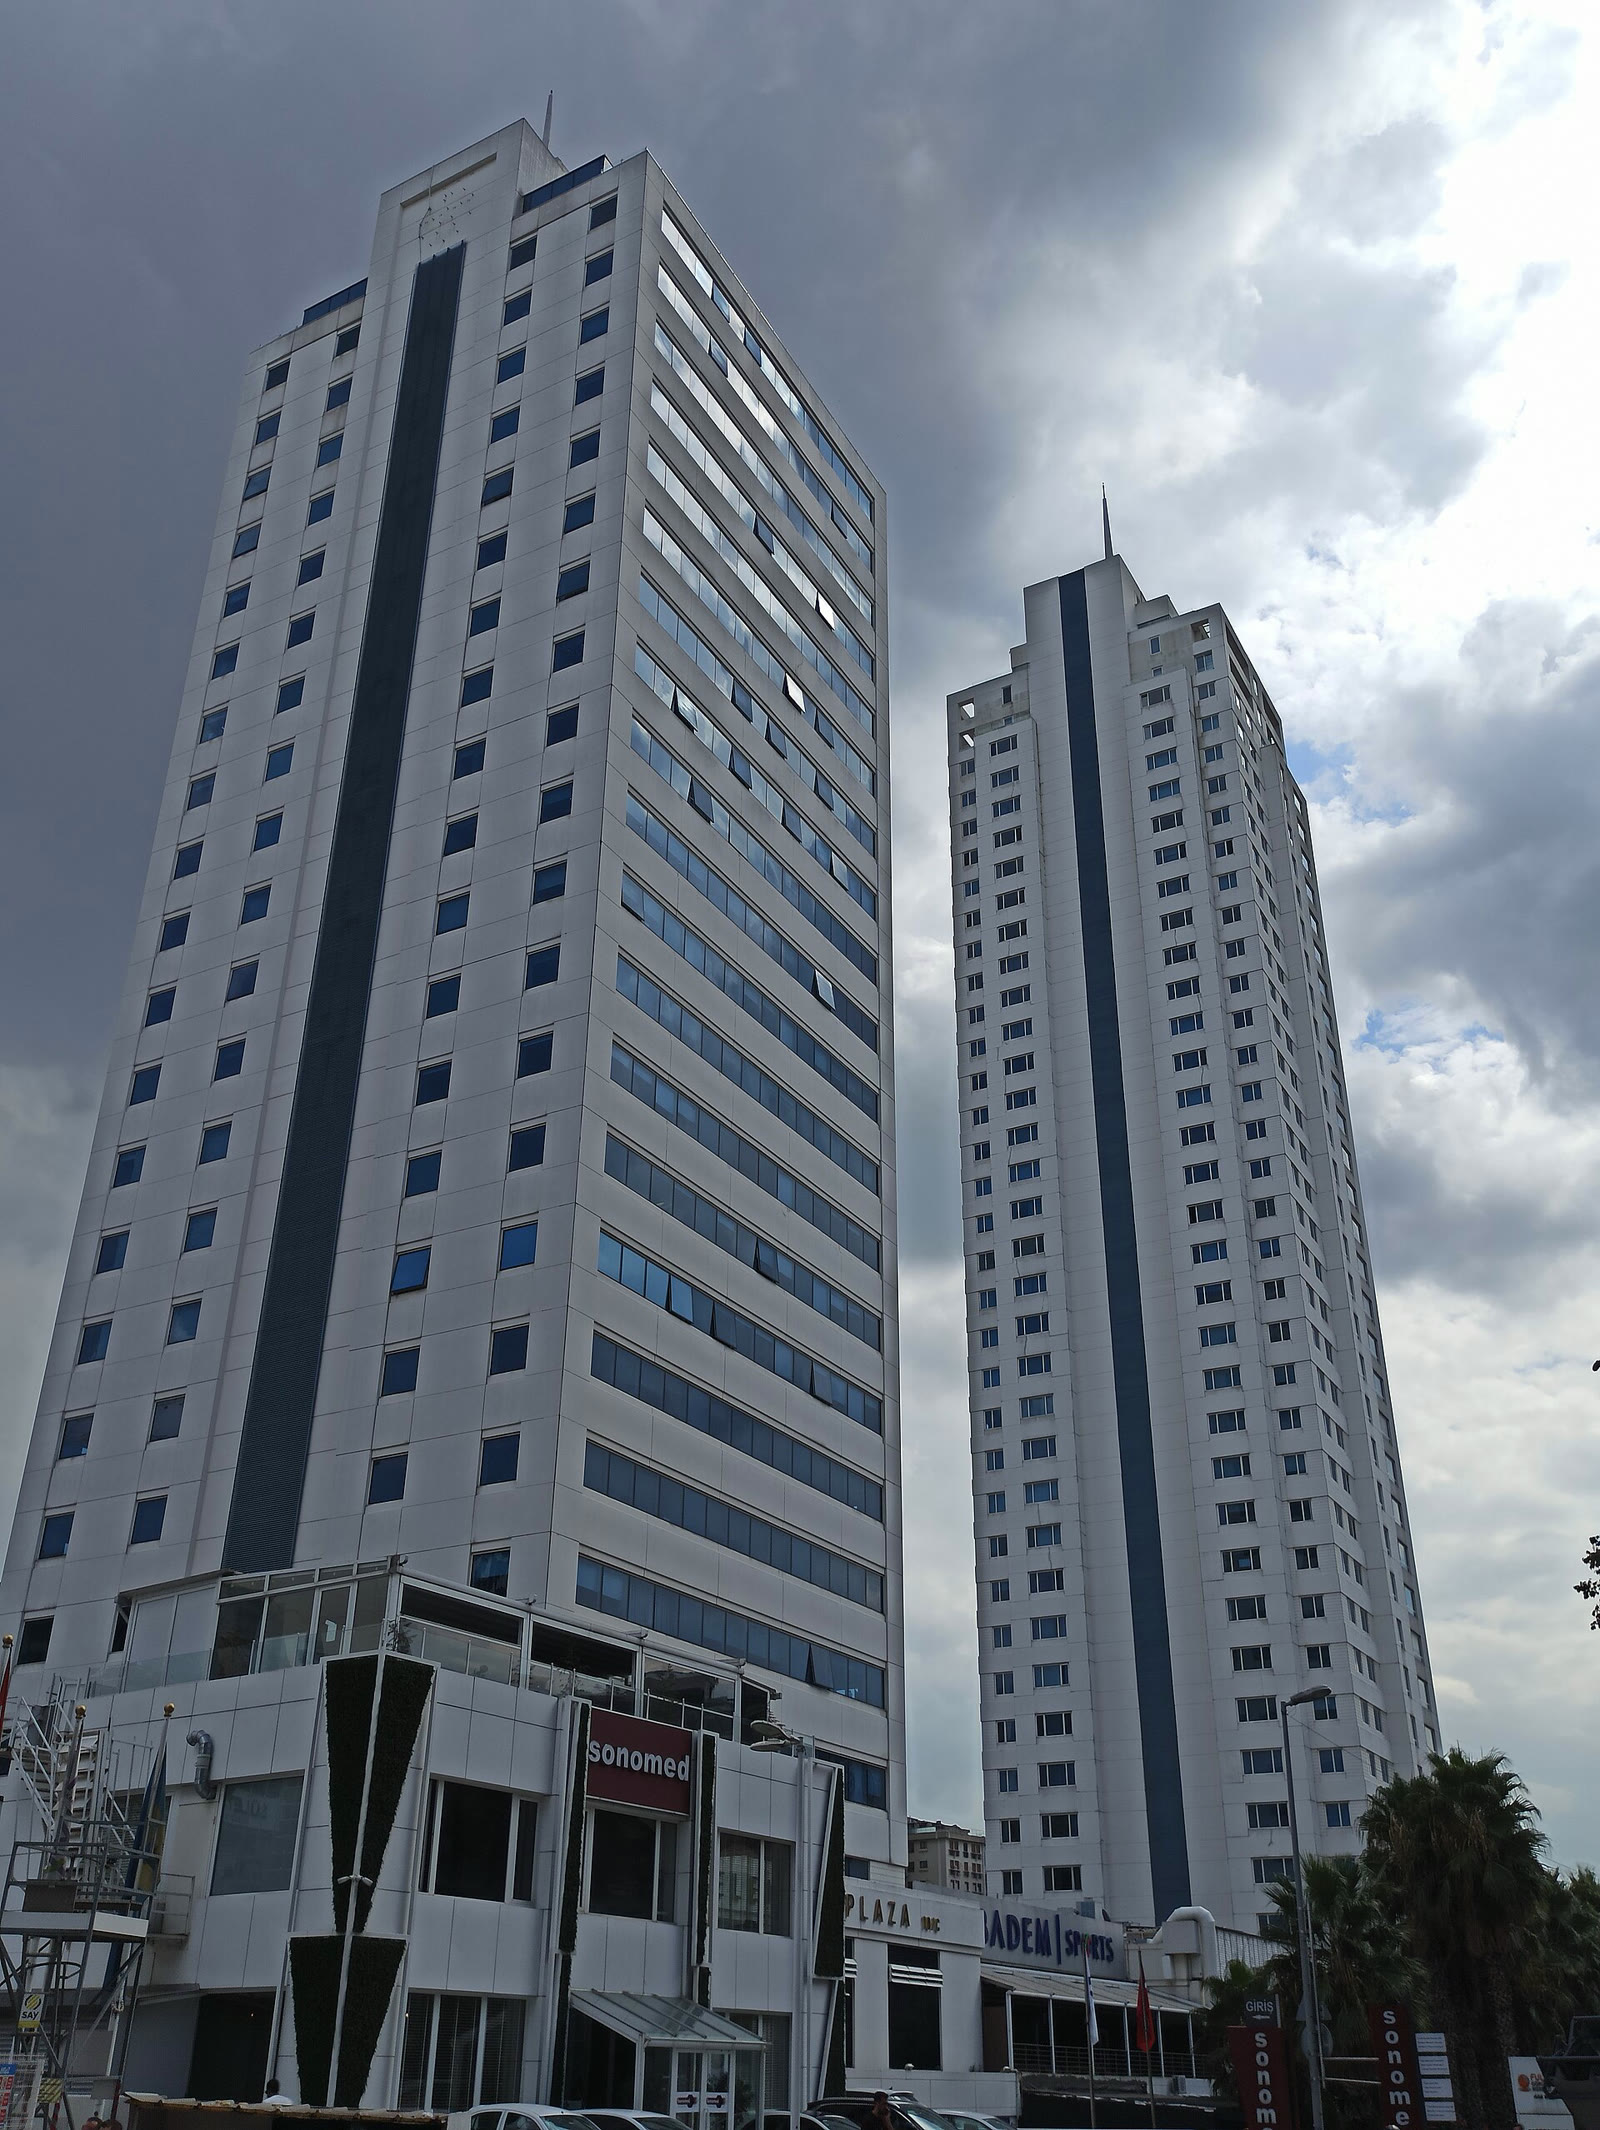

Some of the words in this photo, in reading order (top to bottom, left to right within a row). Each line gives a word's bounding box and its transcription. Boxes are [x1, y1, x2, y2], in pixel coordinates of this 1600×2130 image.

[588, 1738, 690, 1782] sonomed
[844, 1893, 911, 1928] PLAZA
[21, 2011, 40, 2021] SAY
[1254, 2032, 1277, 2130] sonom
